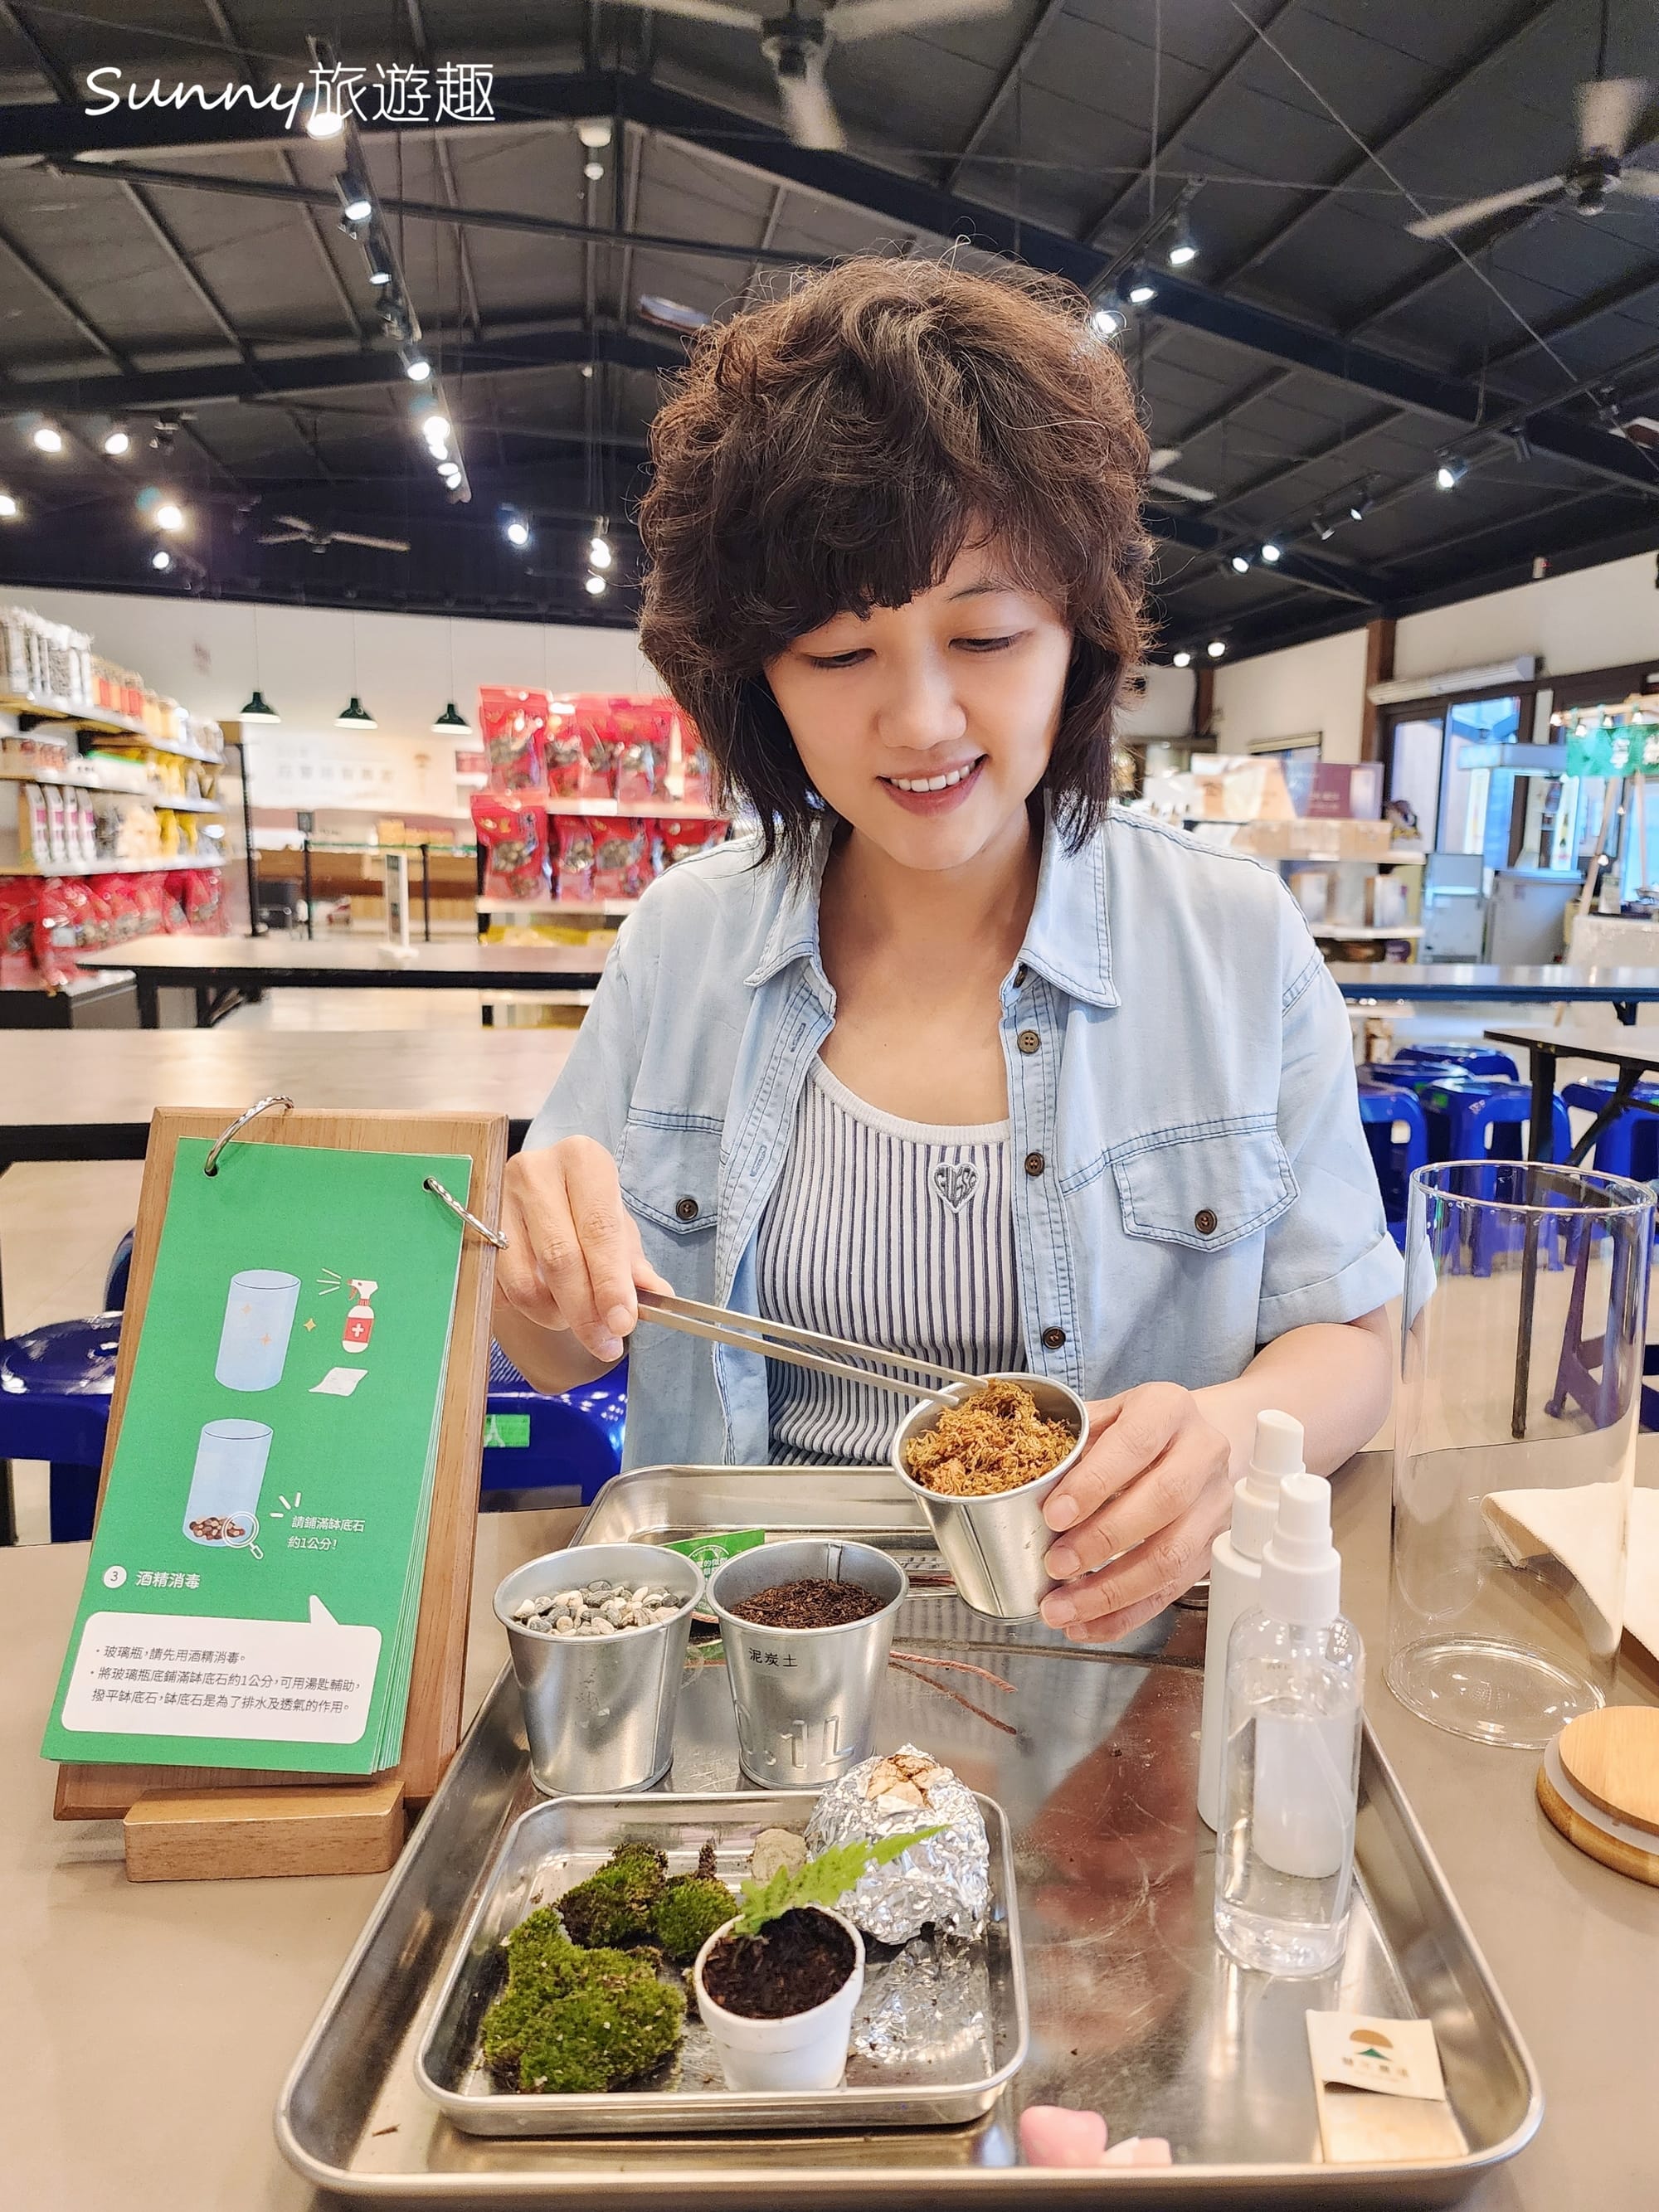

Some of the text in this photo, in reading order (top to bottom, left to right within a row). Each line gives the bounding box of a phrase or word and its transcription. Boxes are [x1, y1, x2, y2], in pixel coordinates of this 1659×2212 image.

[291, 1515, 366, 1533] 請鋪滿缽底石
[135, 1570, 201, 1589] 酒精消毒
[748, 1647, 798, 1667] 泥炭土
